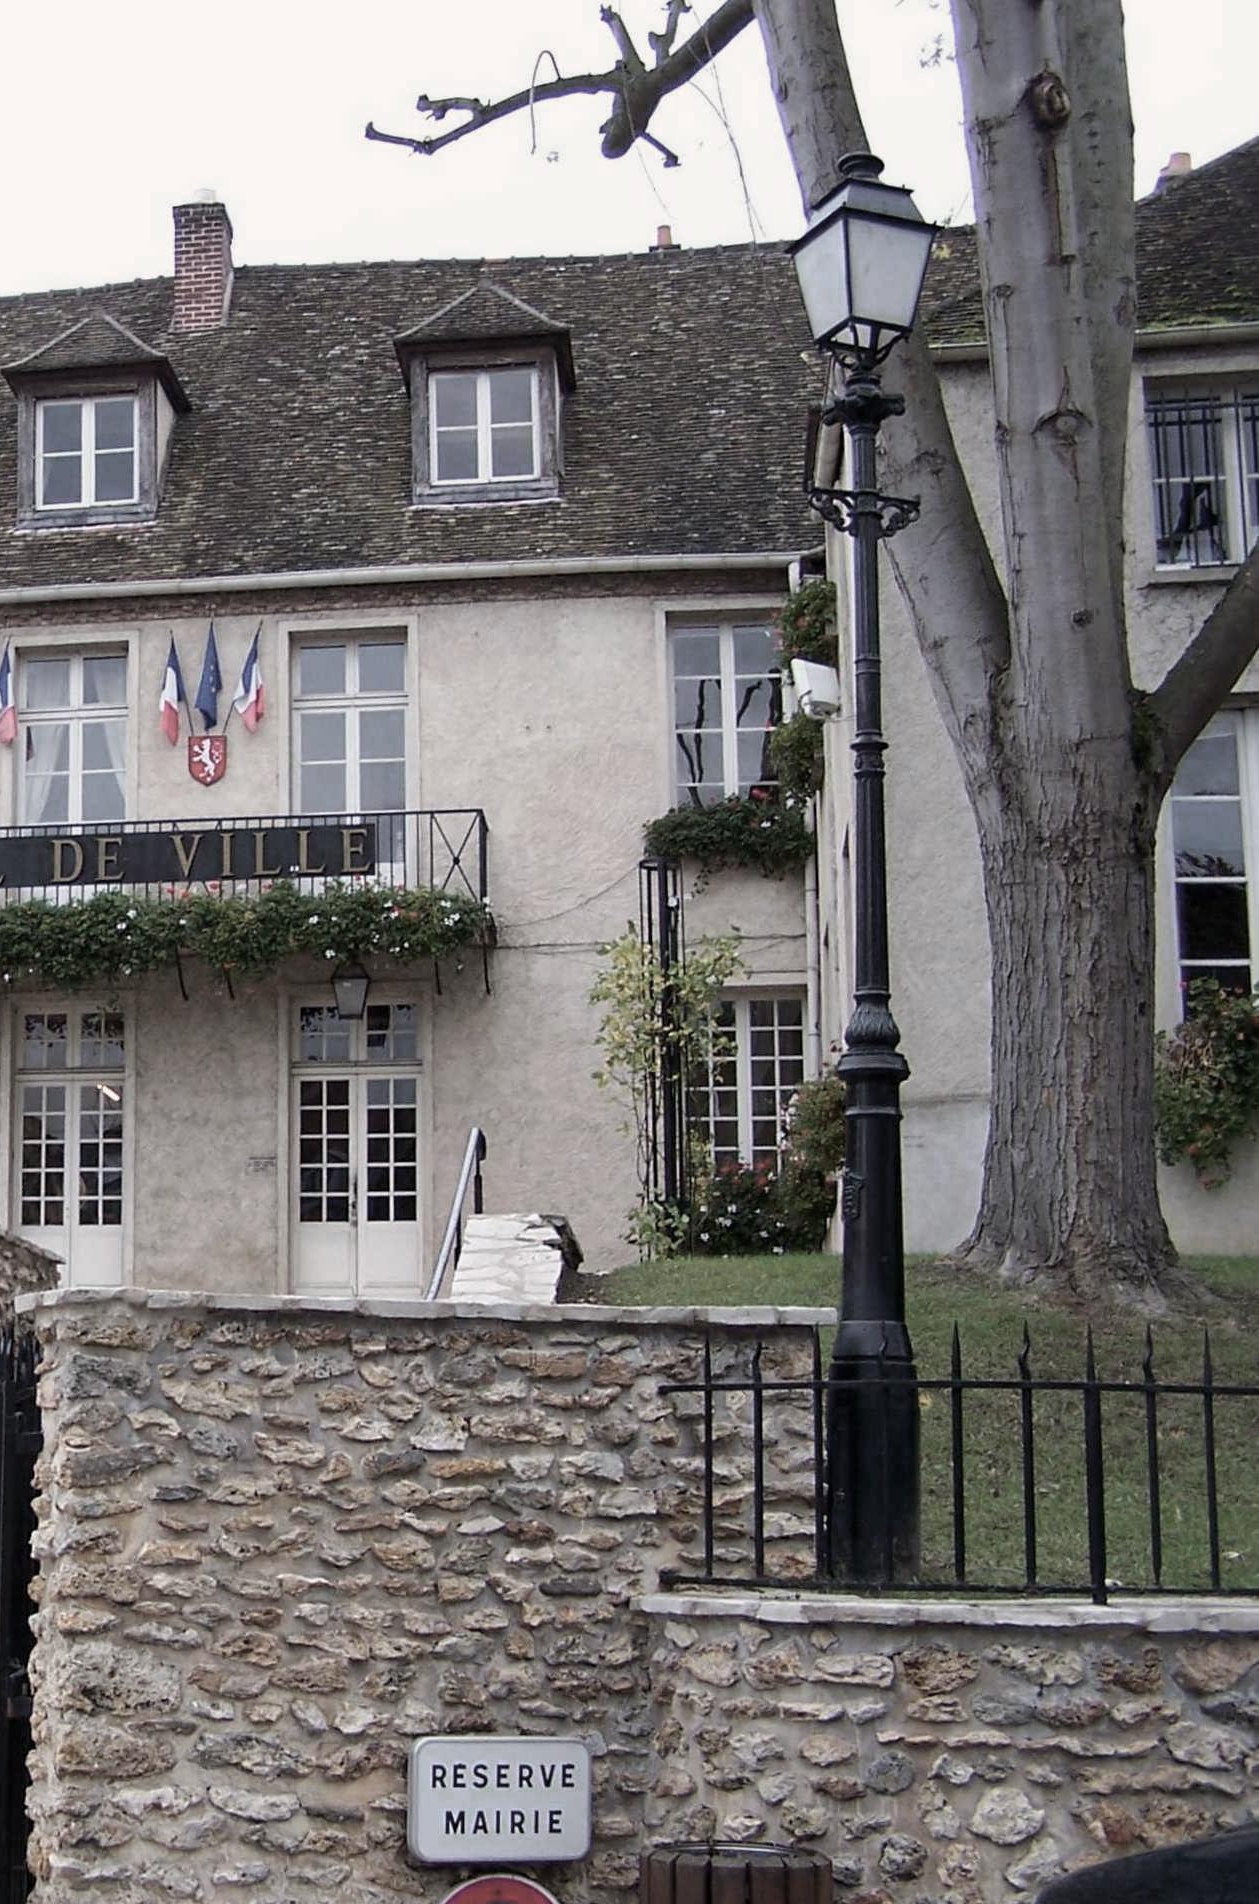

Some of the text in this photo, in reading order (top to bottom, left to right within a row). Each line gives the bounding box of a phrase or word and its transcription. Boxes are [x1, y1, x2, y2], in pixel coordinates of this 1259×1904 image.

[50, 837, 124, 882] DE
[169, 828, 372, 878] VILLE
[444, 1809, 563, 1835] MAIRIE
